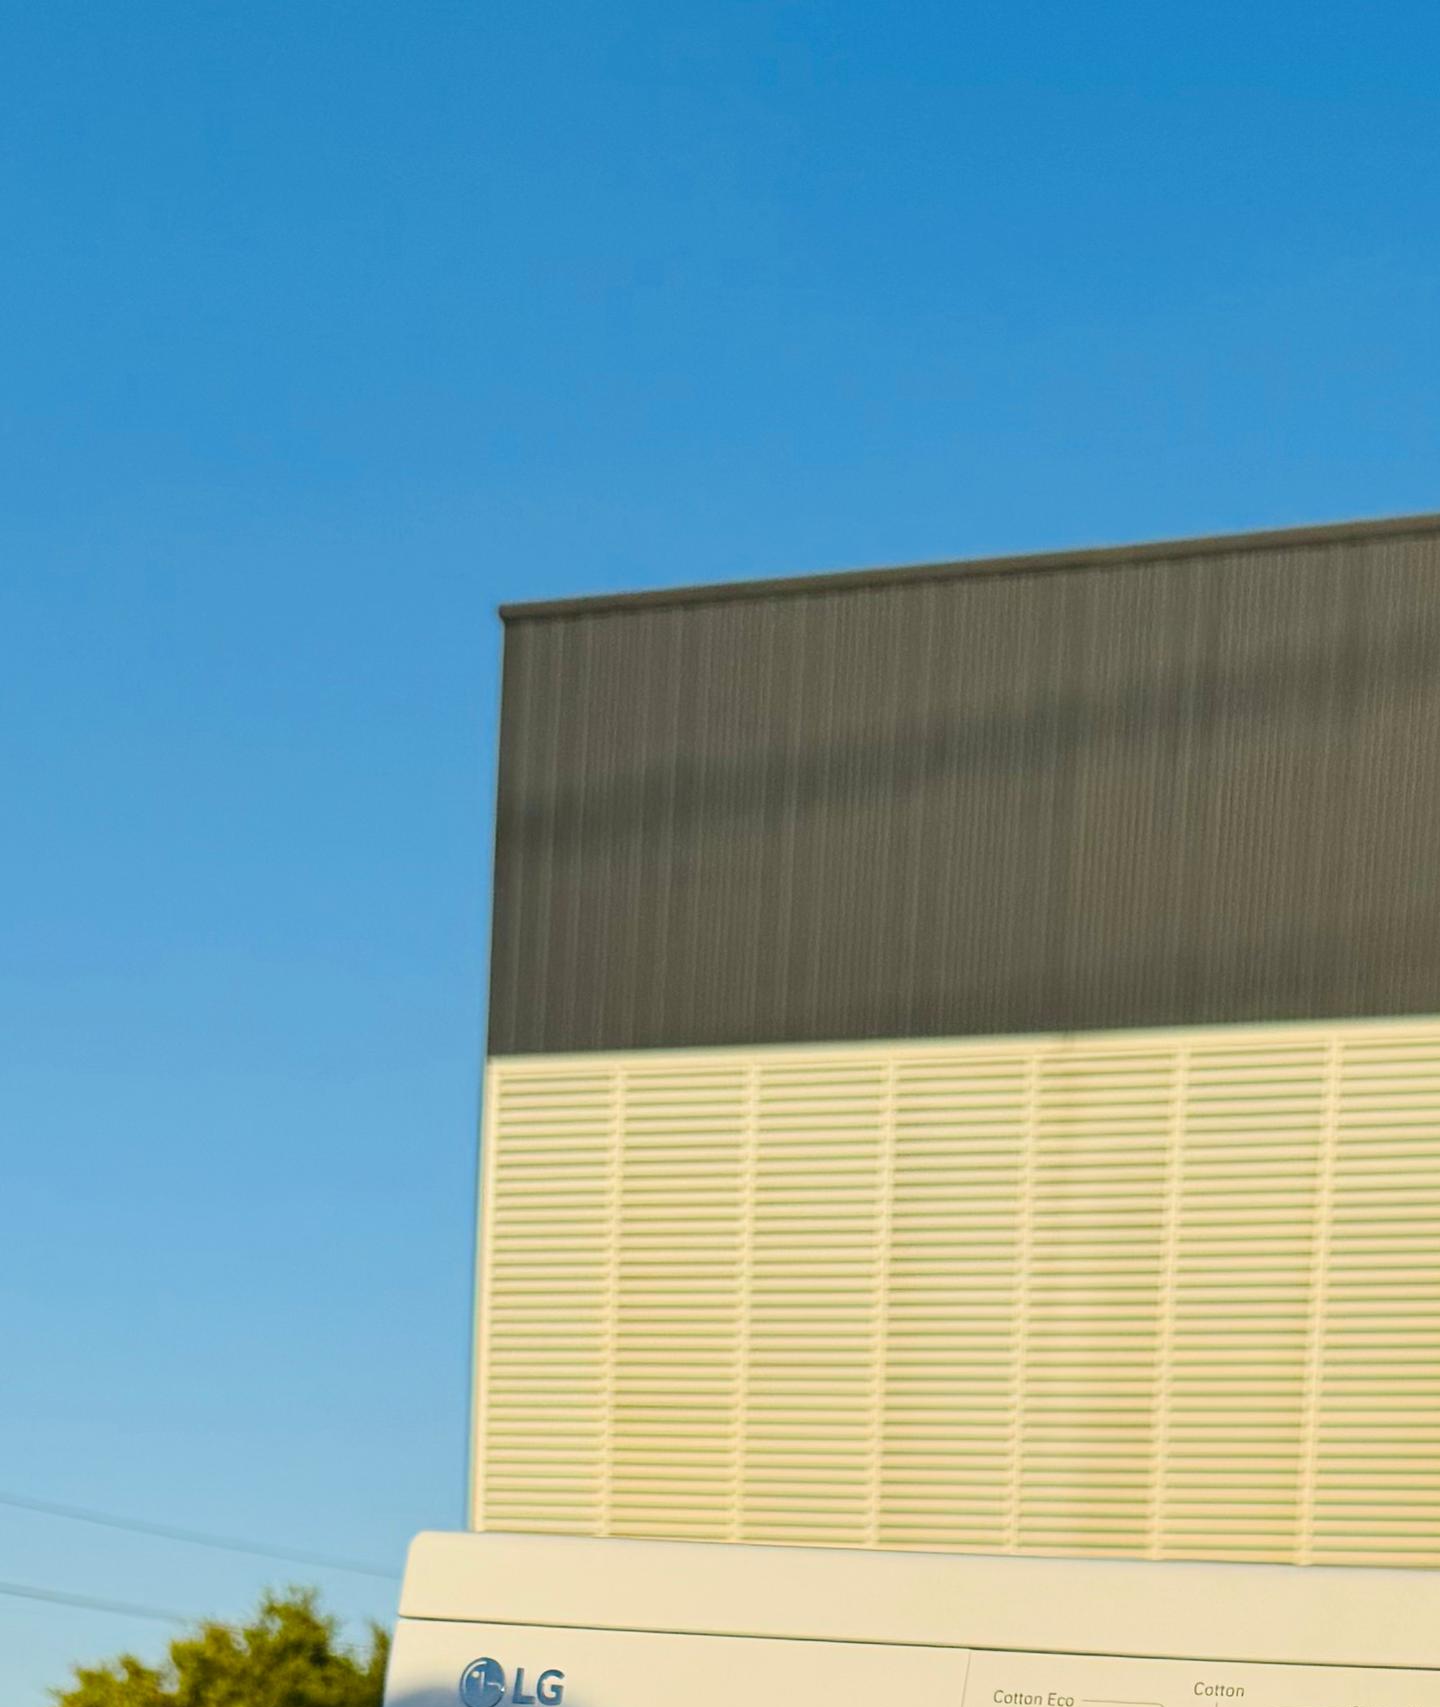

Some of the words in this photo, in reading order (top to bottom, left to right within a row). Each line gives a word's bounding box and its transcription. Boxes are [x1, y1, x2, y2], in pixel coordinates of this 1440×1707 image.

[511, 1668, 565, 1706] LG
[1194, 1682, 1245, 1697] Cotton
[993, 1690, 1042, 1706] Cotton
[1047, 1693, 1074, 1707] Eco
